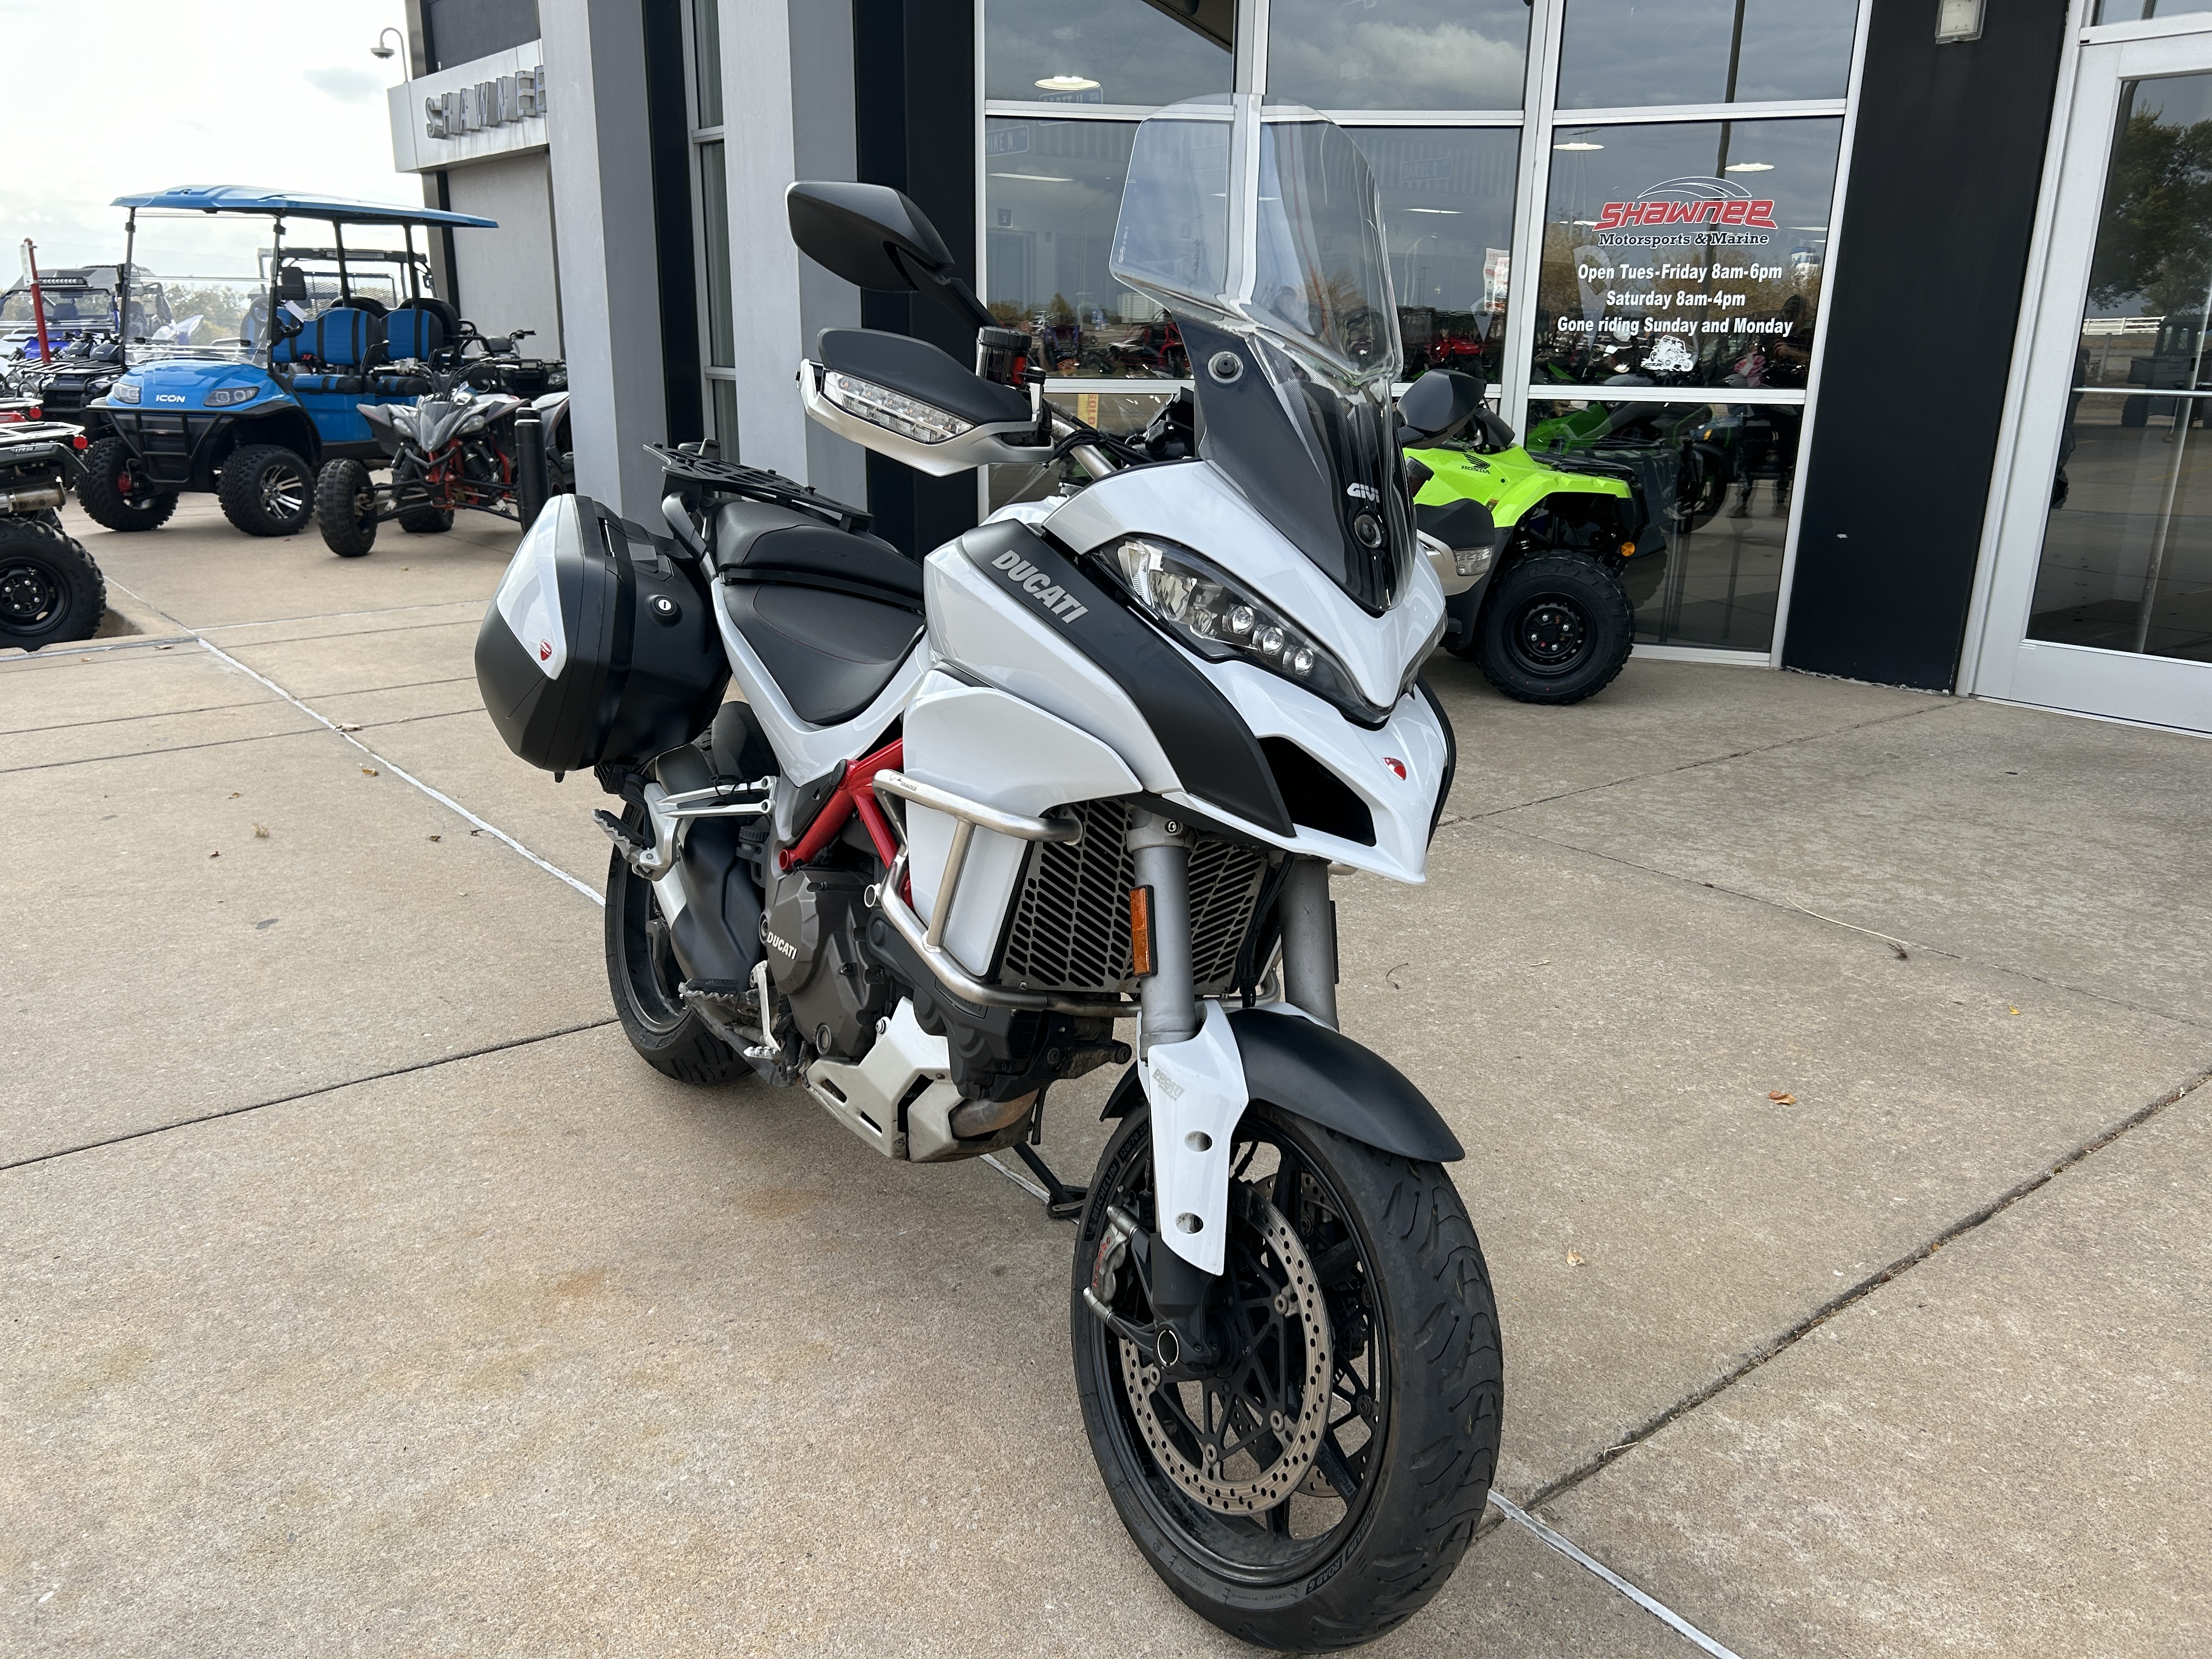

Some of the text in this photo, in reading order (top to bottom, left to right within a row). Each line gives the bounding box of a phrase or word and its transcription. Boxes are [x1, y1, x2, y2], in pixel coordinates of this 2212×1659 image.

[426, 65, 547, 138] SHAWNEE
[1002, 215, 1008, 223] 2
[1599, 232, 1769, 249] Motorsports & Marine
[1578, 263, 1782, 283] Open Tues-Friday 8am-6pm
[1606, 290, 1746, 310] Saturday 8am-4pm
[1557, 316, 1793, 338] Gone riding Sunday and Monday
[155, 394, 185, 403] ICON
[1460, 465, 1491, 475] HONDA
[1347, 482, 1380, 504] GIVI
[991, 550, 1089, 624] DUCATI
[766, 931, 798, 960] DUCATI
[1091, 1163, 1118, 1220] MICHELIN
[1119, 1134, 1140, 1159] 120/70
[1308, 1491, 1382, 1592] MICHELIN ROAD 6
